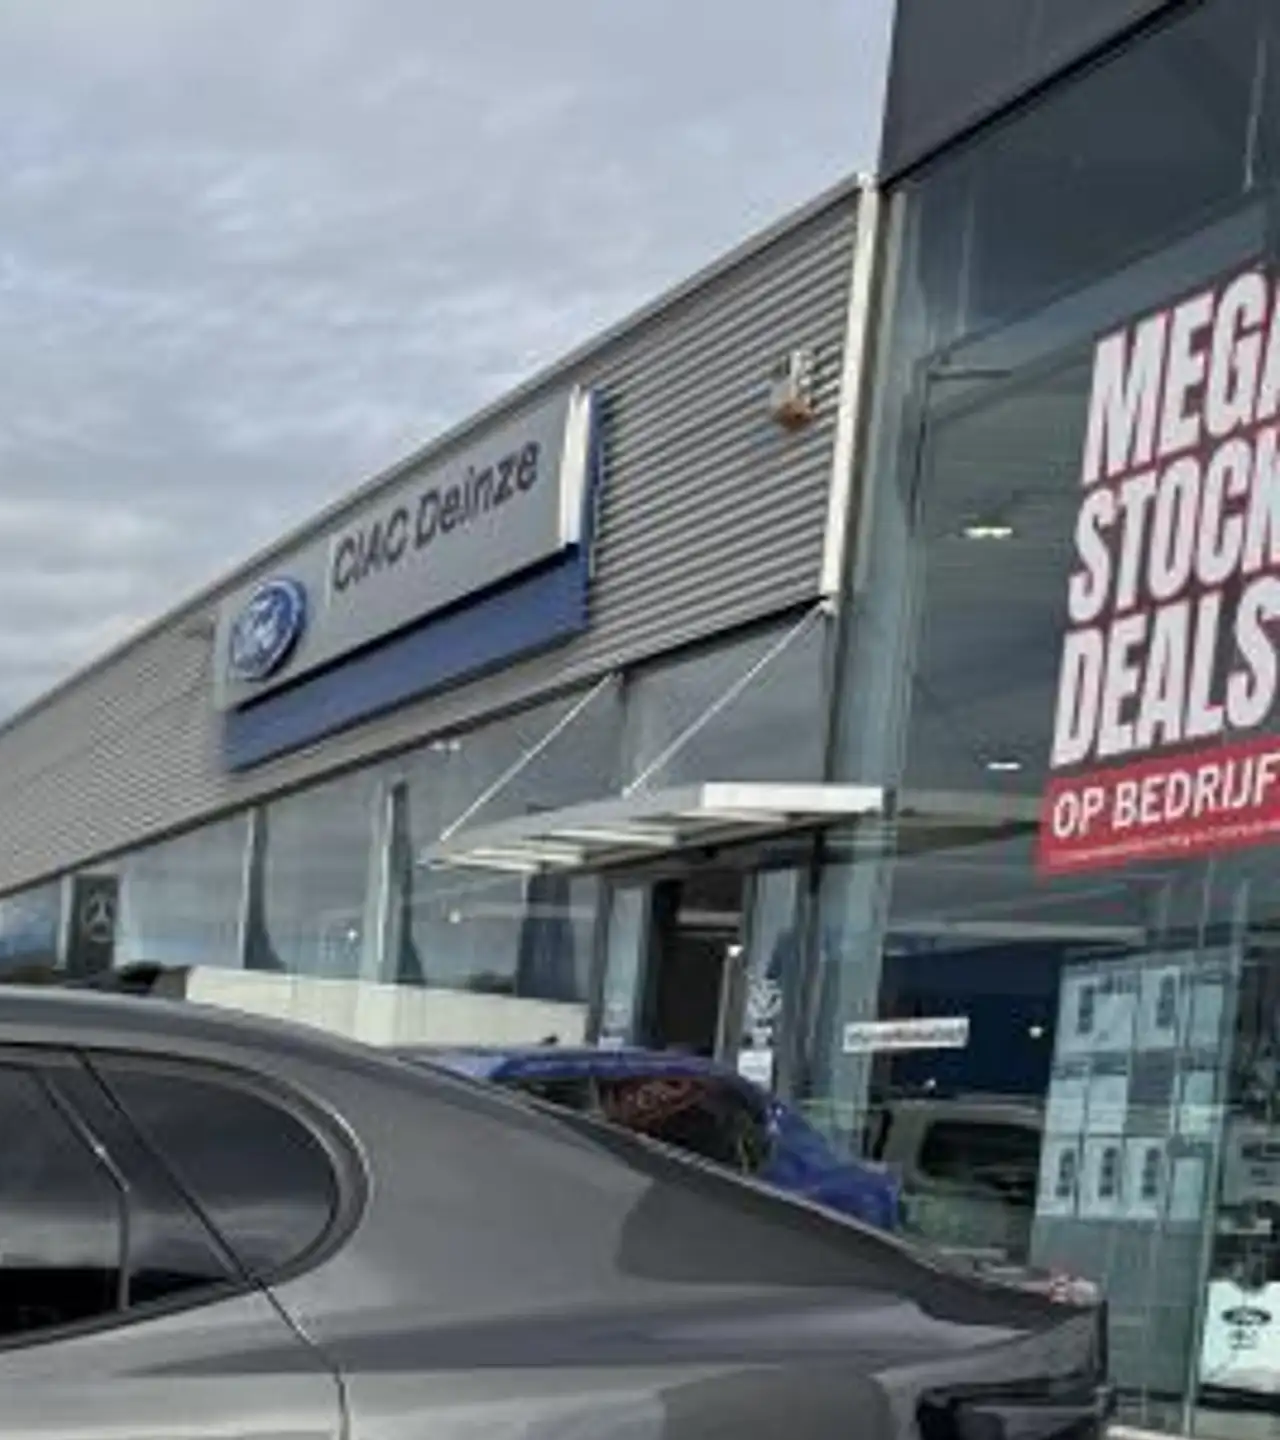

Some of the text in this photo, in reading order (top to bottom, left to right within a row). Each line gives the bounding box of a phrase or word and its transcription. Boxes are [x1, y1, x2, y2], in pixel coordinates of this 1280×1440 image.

[333, 440, 540, 592] CIAC Deinze
[1050, 575, 1280, 768] DEALS
[1053, 787, 1105, 838] OP
